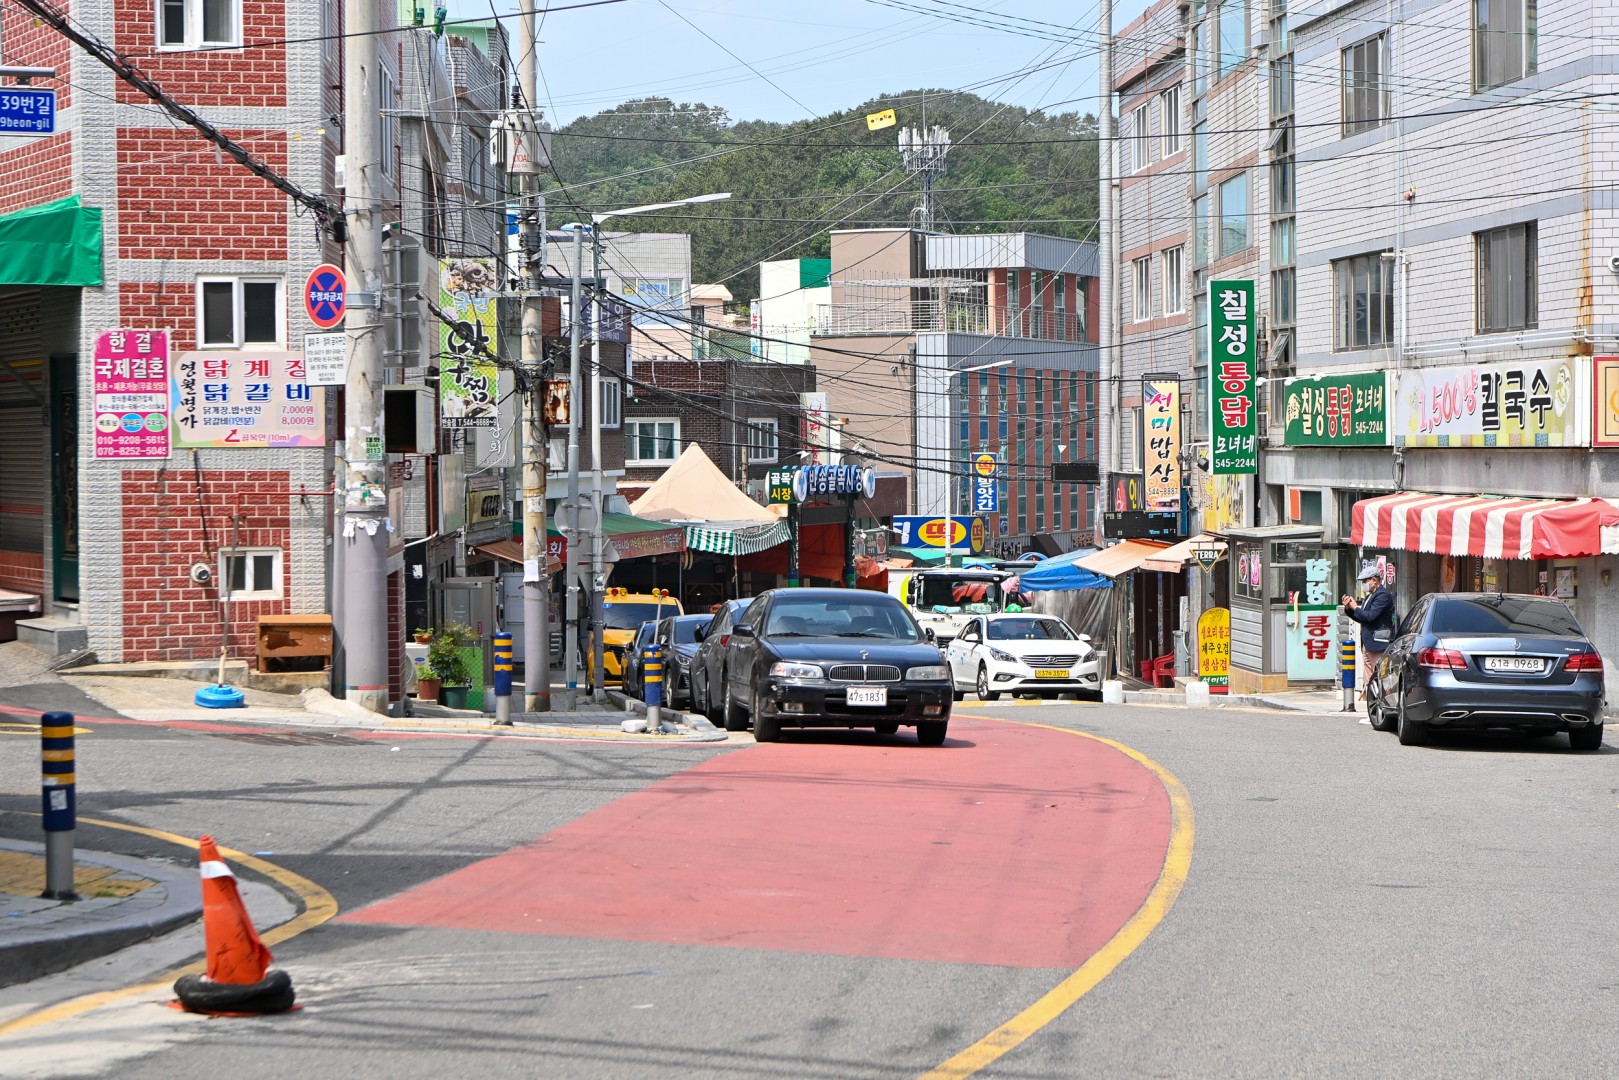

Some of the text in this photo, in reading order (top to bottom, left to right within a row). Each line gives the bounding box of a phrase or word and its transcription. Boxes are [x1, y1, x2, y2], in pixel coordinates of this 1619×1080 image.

[310, 291, 343, 302] 주정차금지
[95, 357, 166, 379] 국제결혼
[1481, 368, 1553, 431] 칼국수
[1355, 421, 1384, 434] 545-2244
[1150, 392, 1175, 483] 선미밥상
[1215, 459, 1255, 468] 545-2244
[770, 472, 791, 485] 골목
[809, 468, 863, 492] 반송골목시장
[771, 488, 791, 500] 시장
[1195, 551, 1220, 559] TERRA
[1513, 659, 1539, 669] 0968
